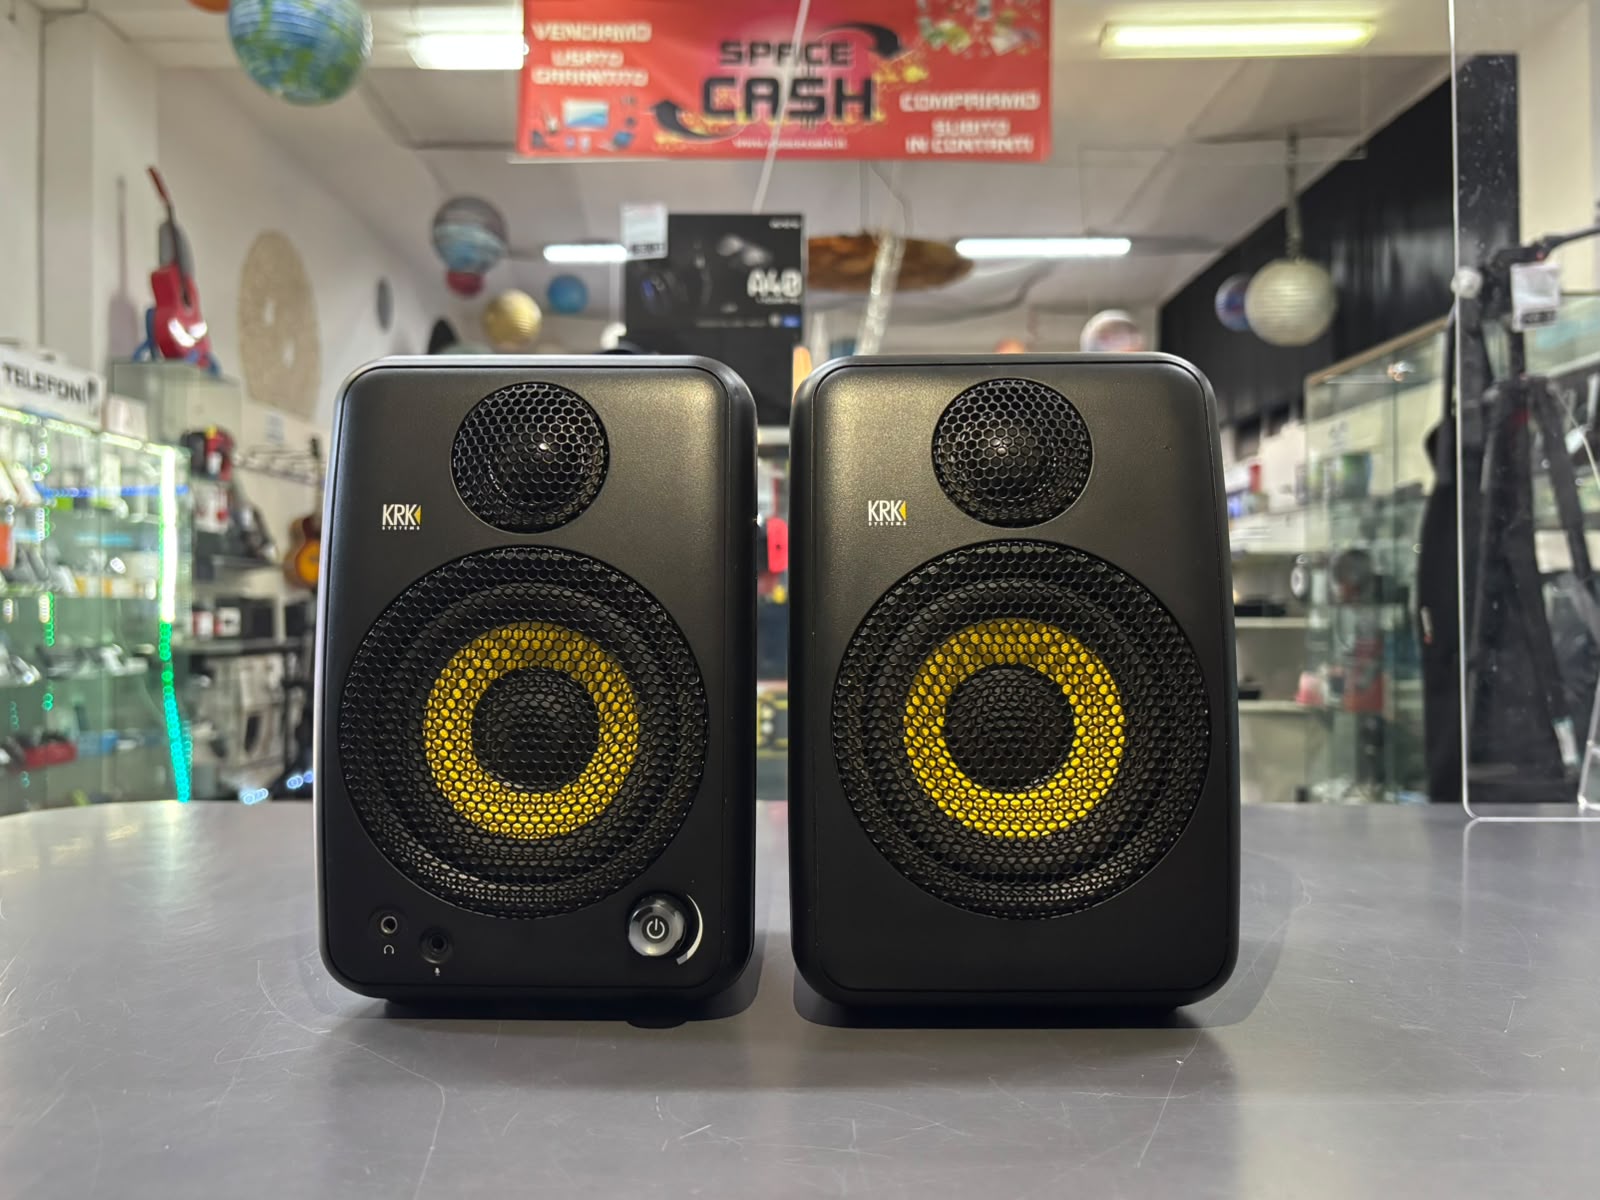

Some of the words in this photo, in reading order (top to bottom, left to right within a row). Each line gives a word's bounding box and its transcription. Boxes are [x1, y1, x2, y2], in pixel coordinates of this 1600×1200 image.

[531, 22, 651, 42] VENDIAMO
[720, 41, 852, 65] SPACE
[703, 76, 874, 121] CASH
[900, 91, 1041, 111] COMPRIAMO
[931, 118, 1011, 136] SUBITO
[905, 136, 928, 153] IN
[931, 135, 1034, 153] CONTANTI
[382, 503, 418, 526] KRK
[868, 500, 903, 522] KRK
